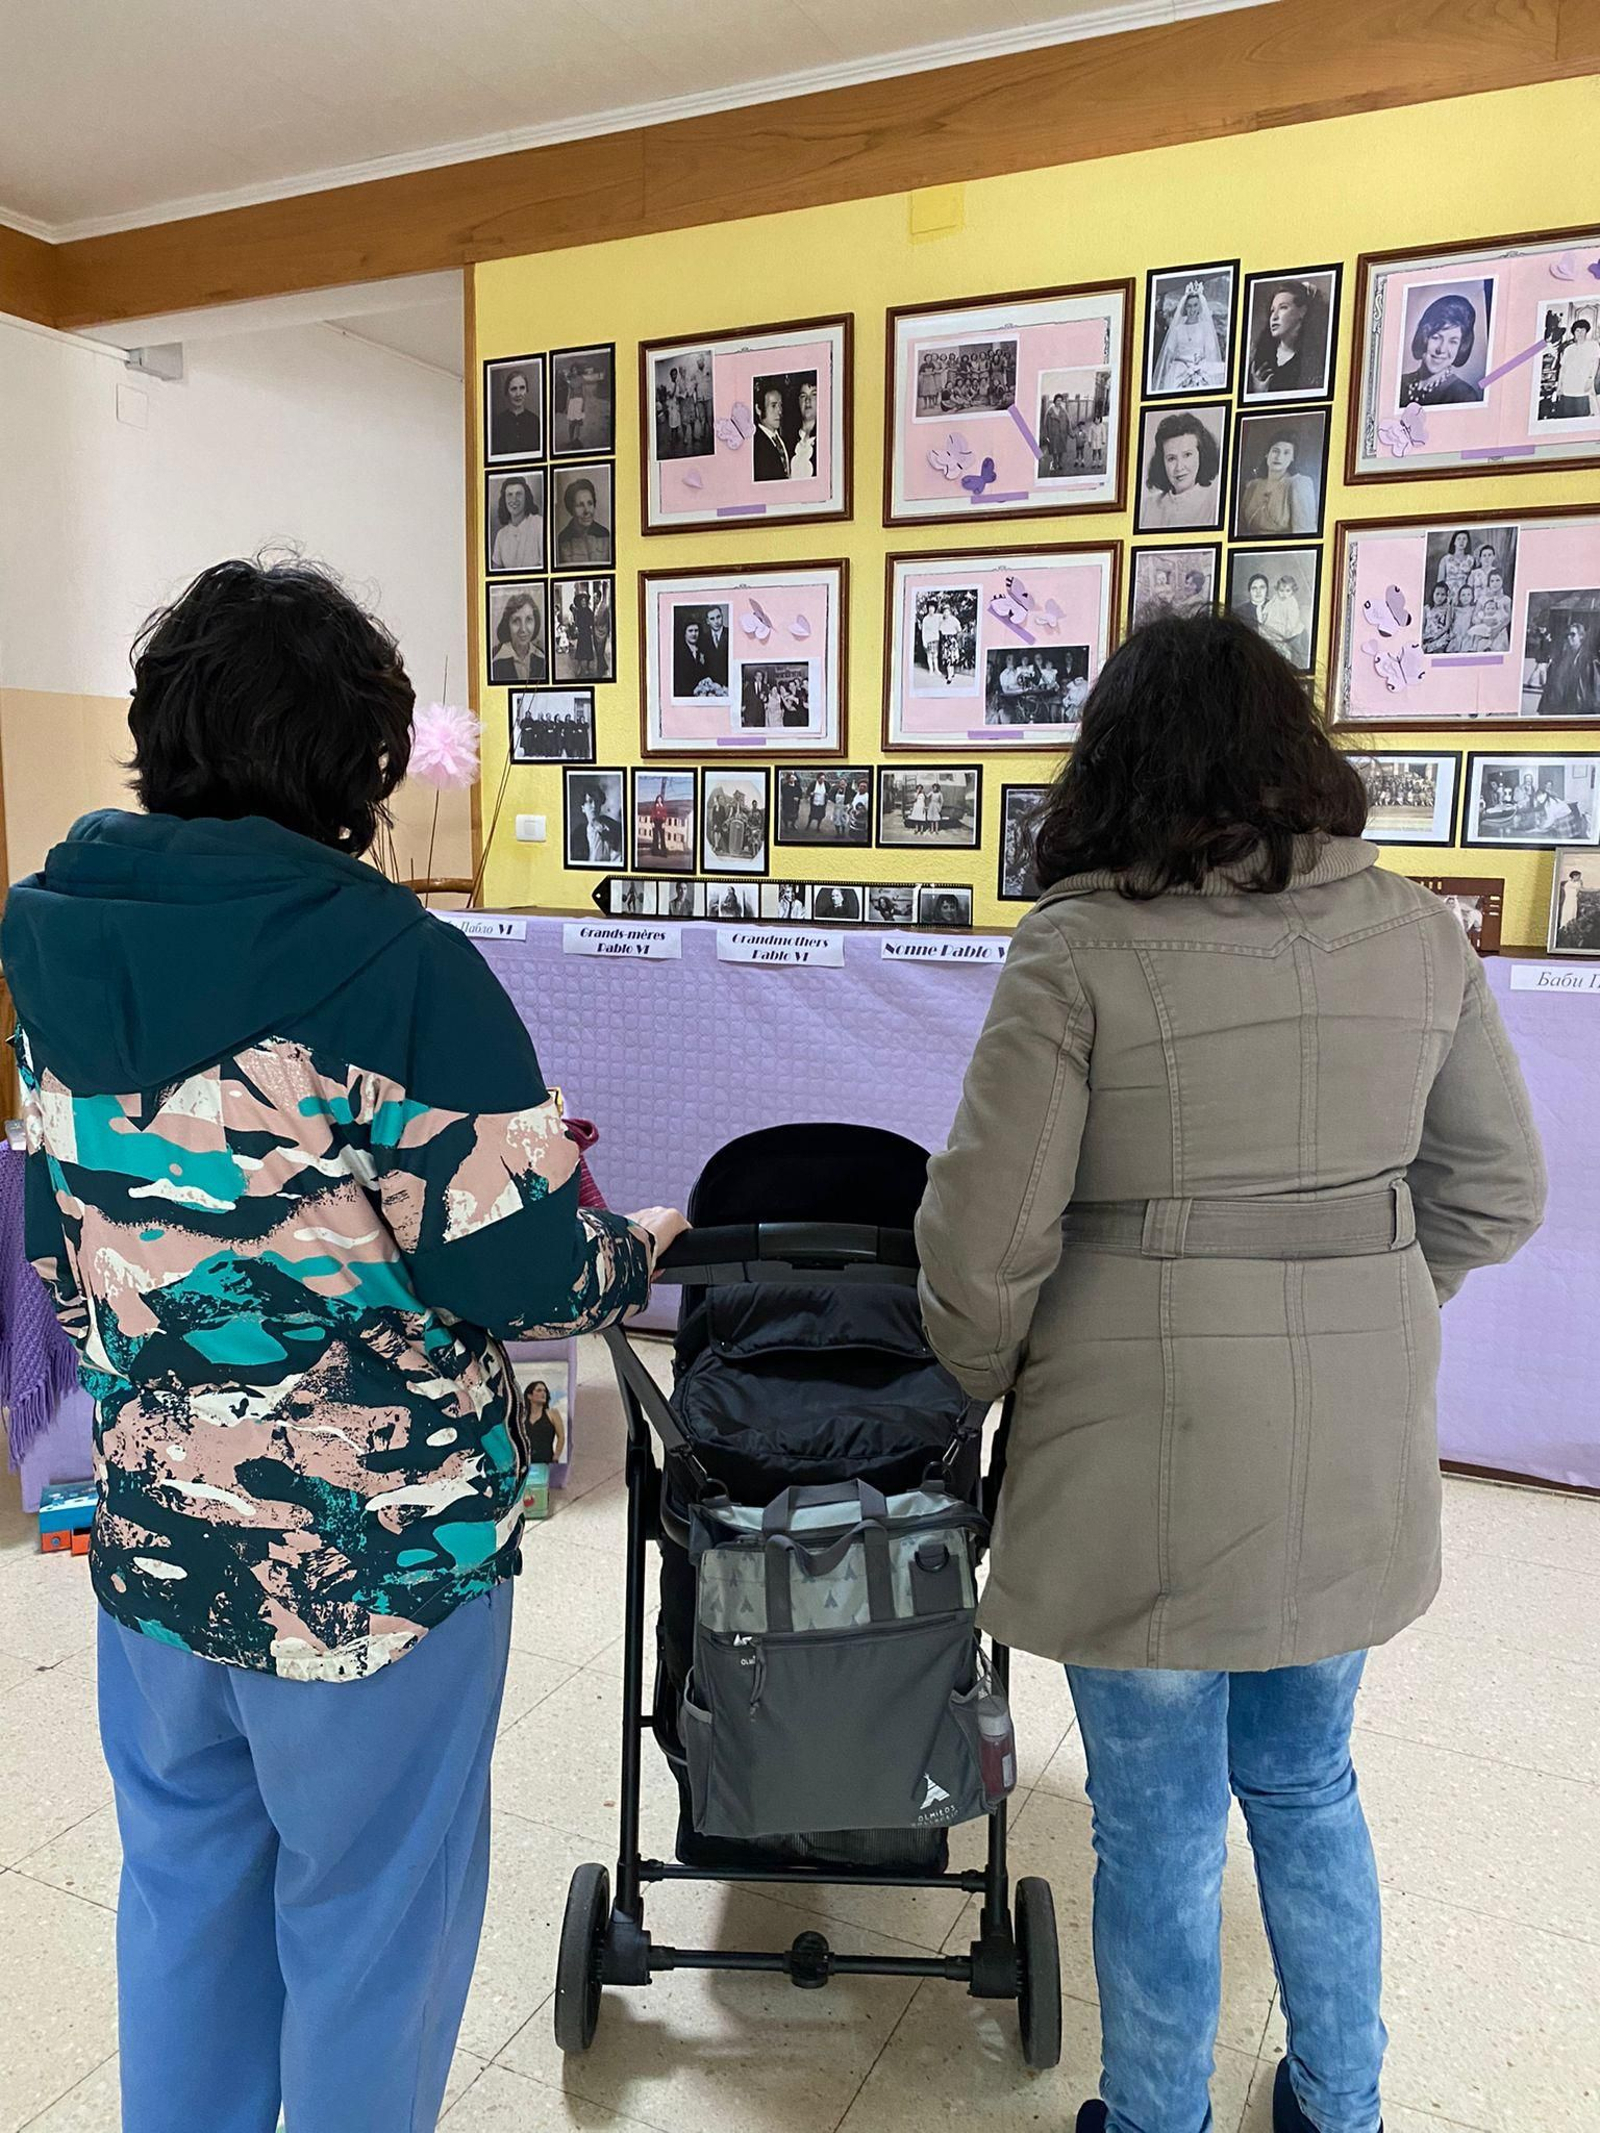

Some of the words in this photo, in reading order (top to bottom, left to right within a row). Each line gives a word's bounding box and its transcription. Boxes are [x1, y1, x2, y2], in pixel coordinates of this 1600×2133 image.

[498, 924, 513, 935] VI
[580, 927, 667, 940] Grands-mères
[732, 933, 829, 948] Grandmothers
[597, 943, 633, 954] Pablo
[636, 944, 650, 955] VI
[751, 949, 792, 961] Pablo
[795, 951, 809, 962] VI
[883, 943, 938, 956] Nonne
[940, 944, 993, 958] Pablo
[1537, 971, 1584, 988] Баби
